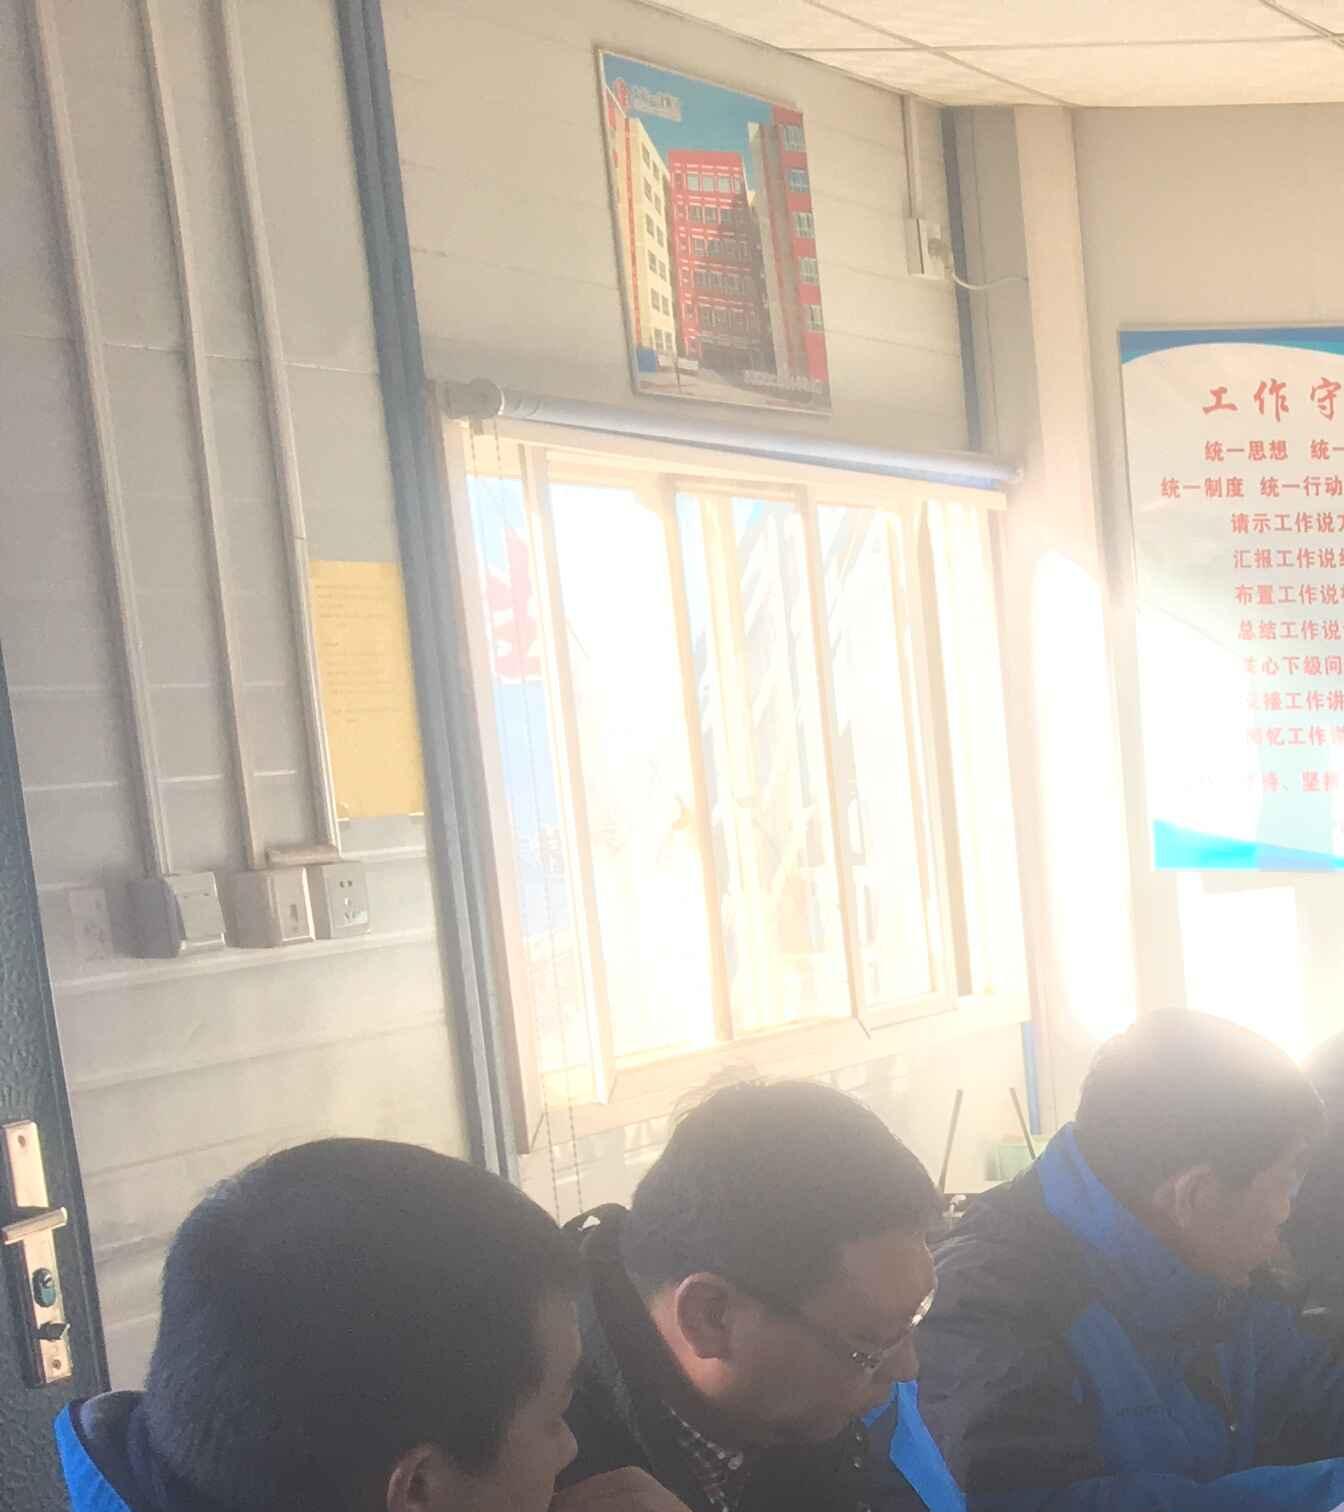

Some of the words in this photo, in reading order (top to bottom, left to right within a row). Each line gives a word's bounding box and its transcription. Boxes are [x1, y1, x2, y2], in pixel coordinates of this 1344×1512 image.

[1204, 440, 1289, 462] 统一思想
[1160, 476, 1245, 499] 统一制度
[1259, 475, 1343, 498] 统一行动
